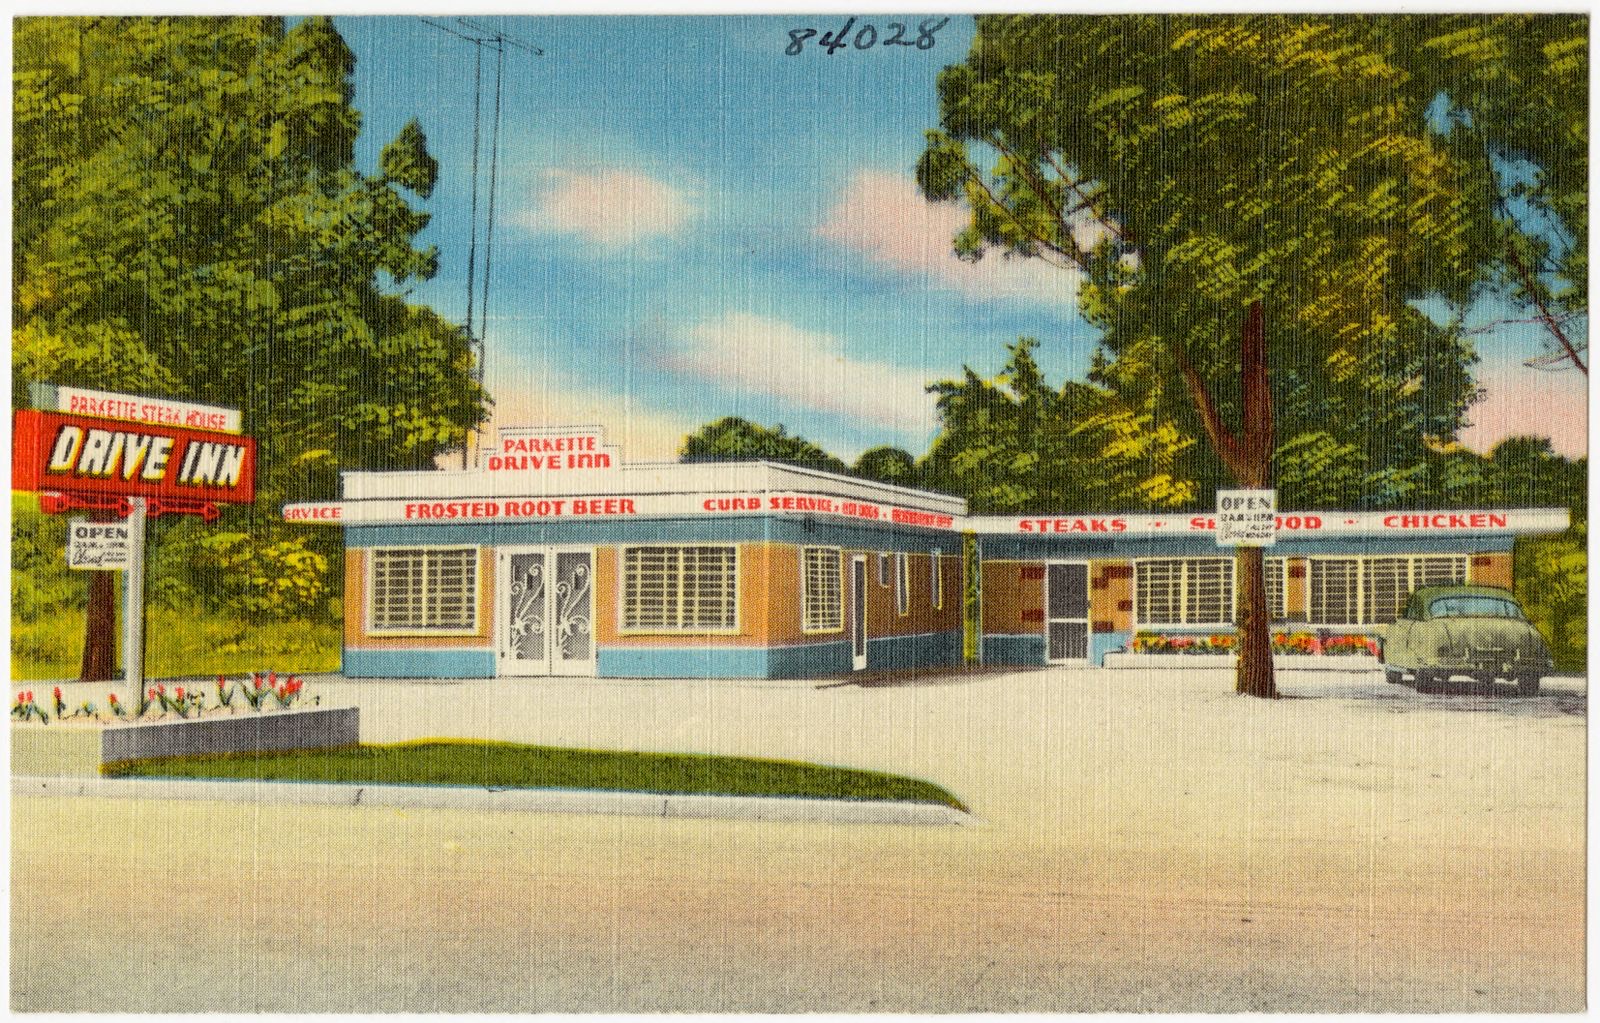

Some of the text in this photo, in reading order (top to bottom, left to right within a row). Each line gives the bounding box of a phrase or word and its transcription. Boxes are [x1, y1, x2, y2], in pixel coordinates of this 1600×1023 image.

[785, 16, 950, 56] 84028
[70, 395, 137, 421] PARKETTE
[185, 409, 226, 431] HOUSE
[503, 437, 597, 453] PARKETTE
[46, 424, 246, 488] DRIVE INN
[488, 455, 562, 471] DRIVE
[404, 498, 636, 520] FROSTED ROOT BEER
[703, 496, 832, 513] CURB SERVICE
[1221, 497, 1271, 510] OPEN
[1018, 518, 1128, 533] STEAKS
[1189, 515, 1323, 531] SEOD
[1383, 513, 1508, 529] CHICKEN
[75, 526, 129, 539] OPEN
